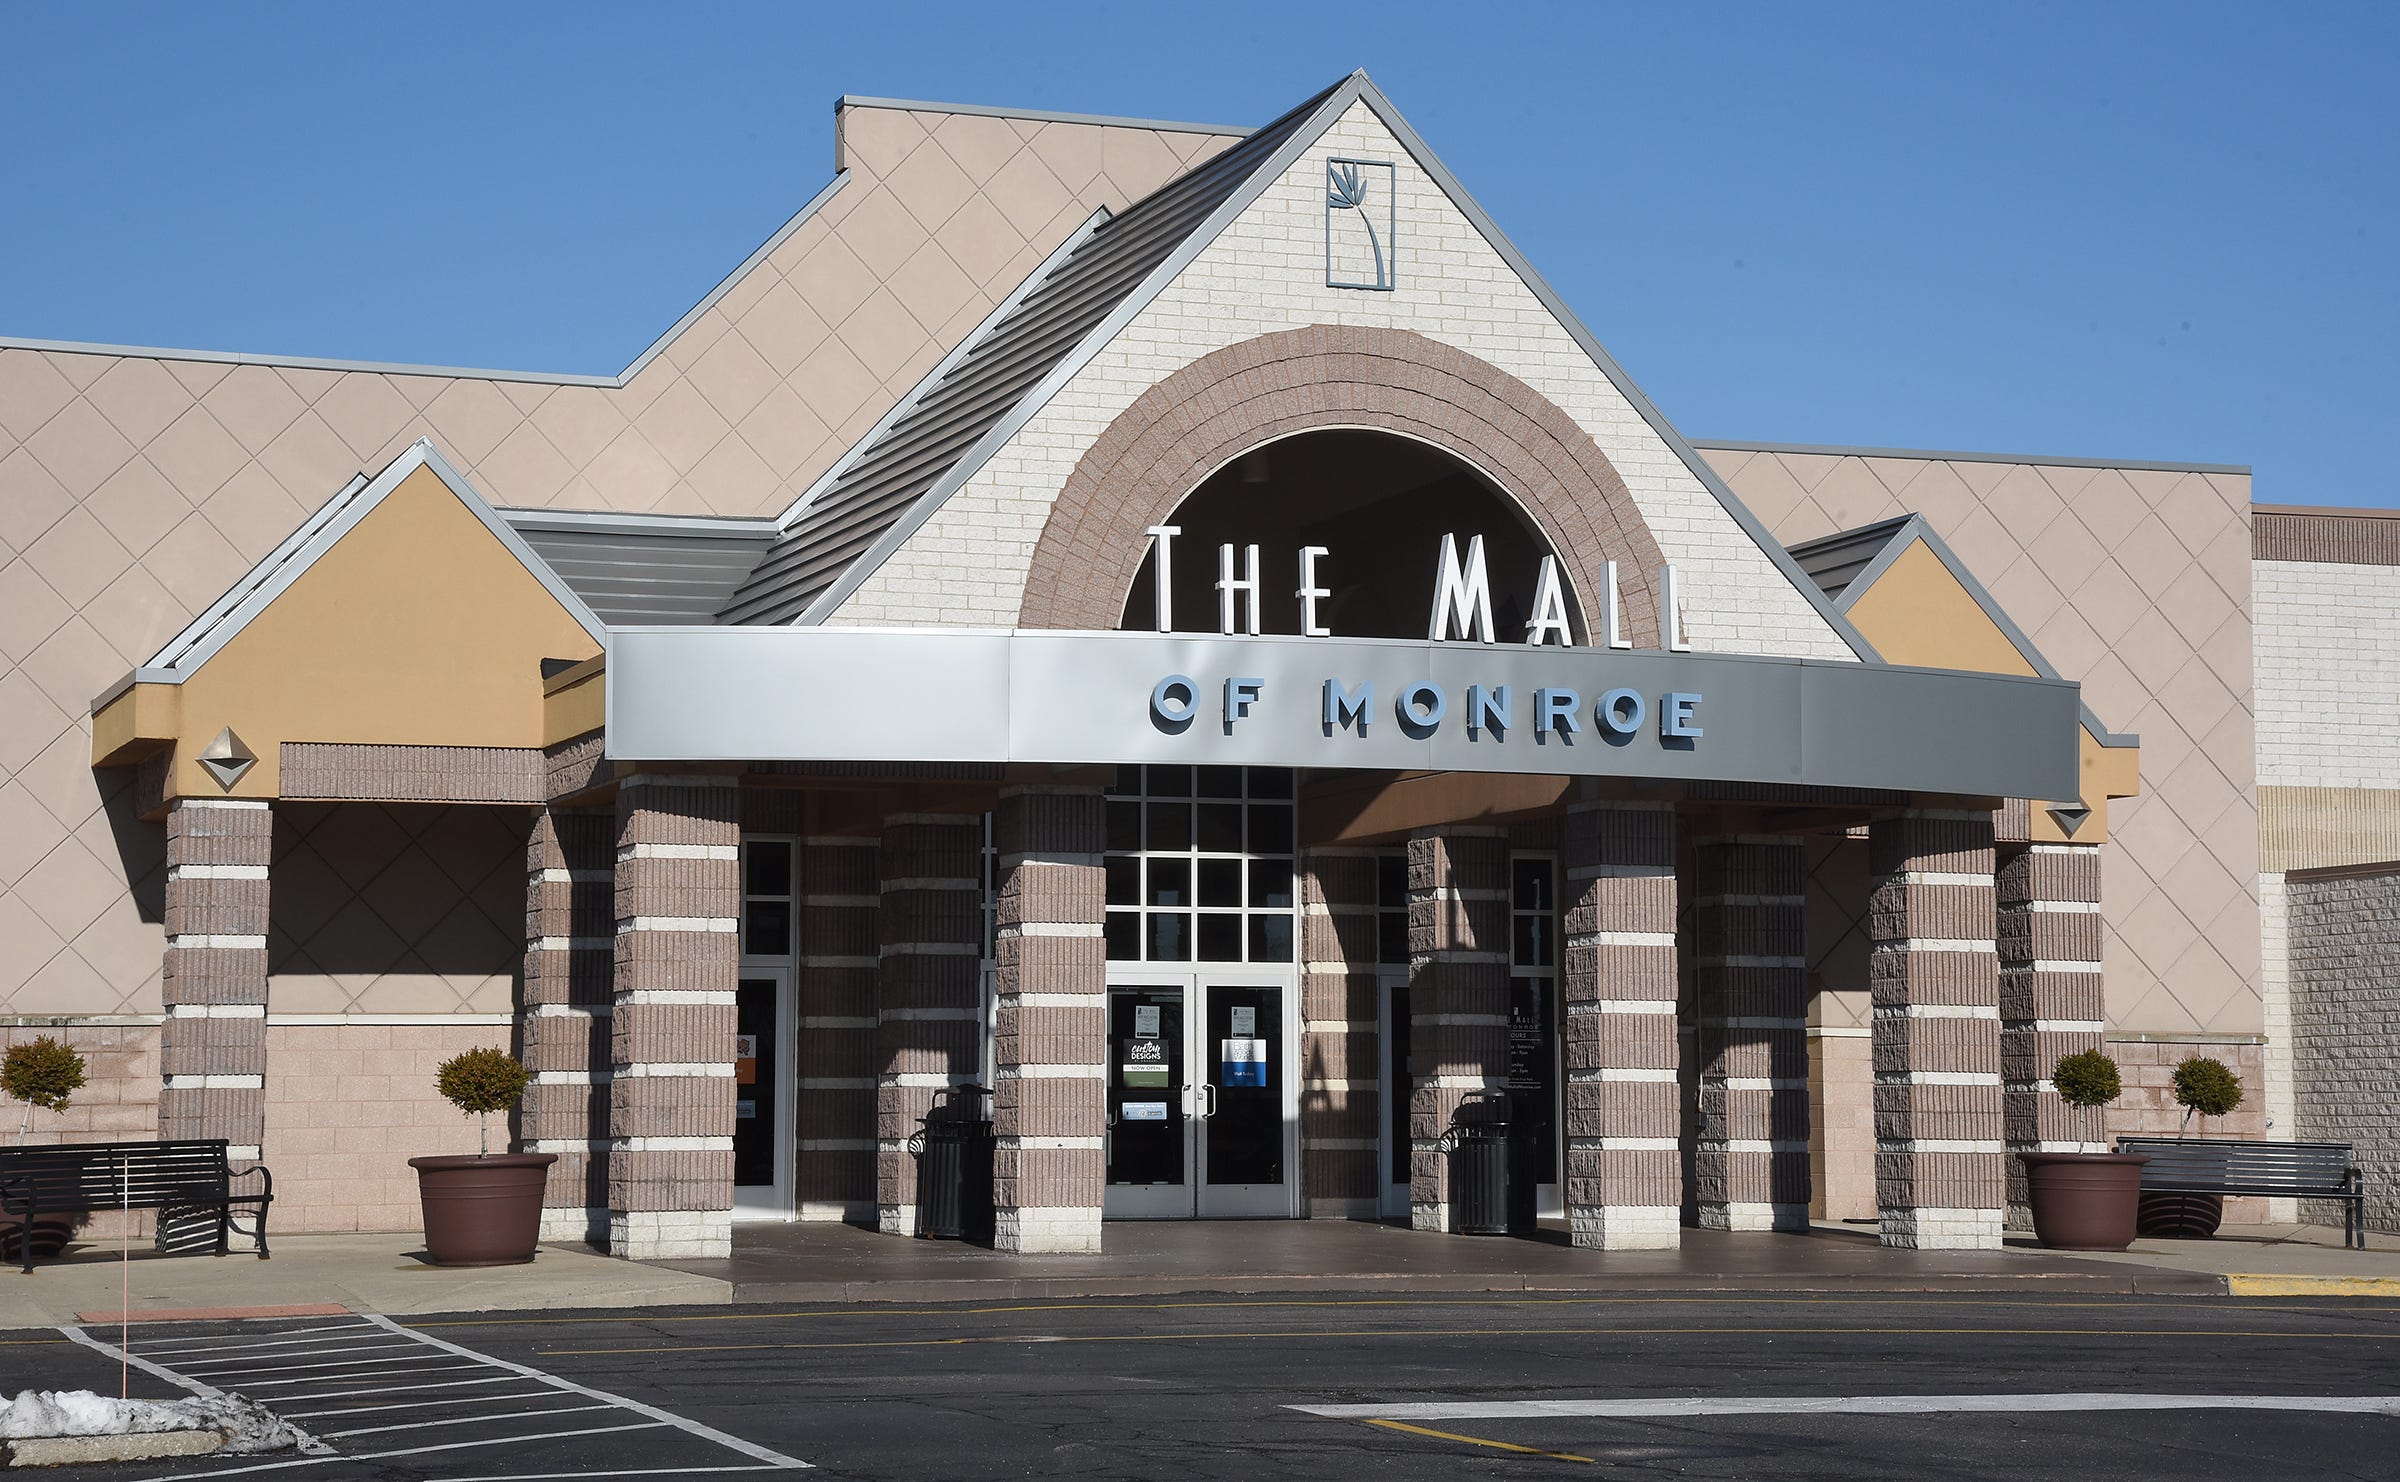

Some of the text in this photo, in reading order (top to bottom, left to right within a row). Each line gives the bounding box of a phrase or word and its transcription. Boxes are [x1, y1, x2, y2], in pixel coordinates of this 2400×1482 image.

[1145, 525, 1692, 653] THE MALL
[1152, 674, 1704, 739] OF MONROE
[1131, 1052, 1161, 1060] DESIGNS
